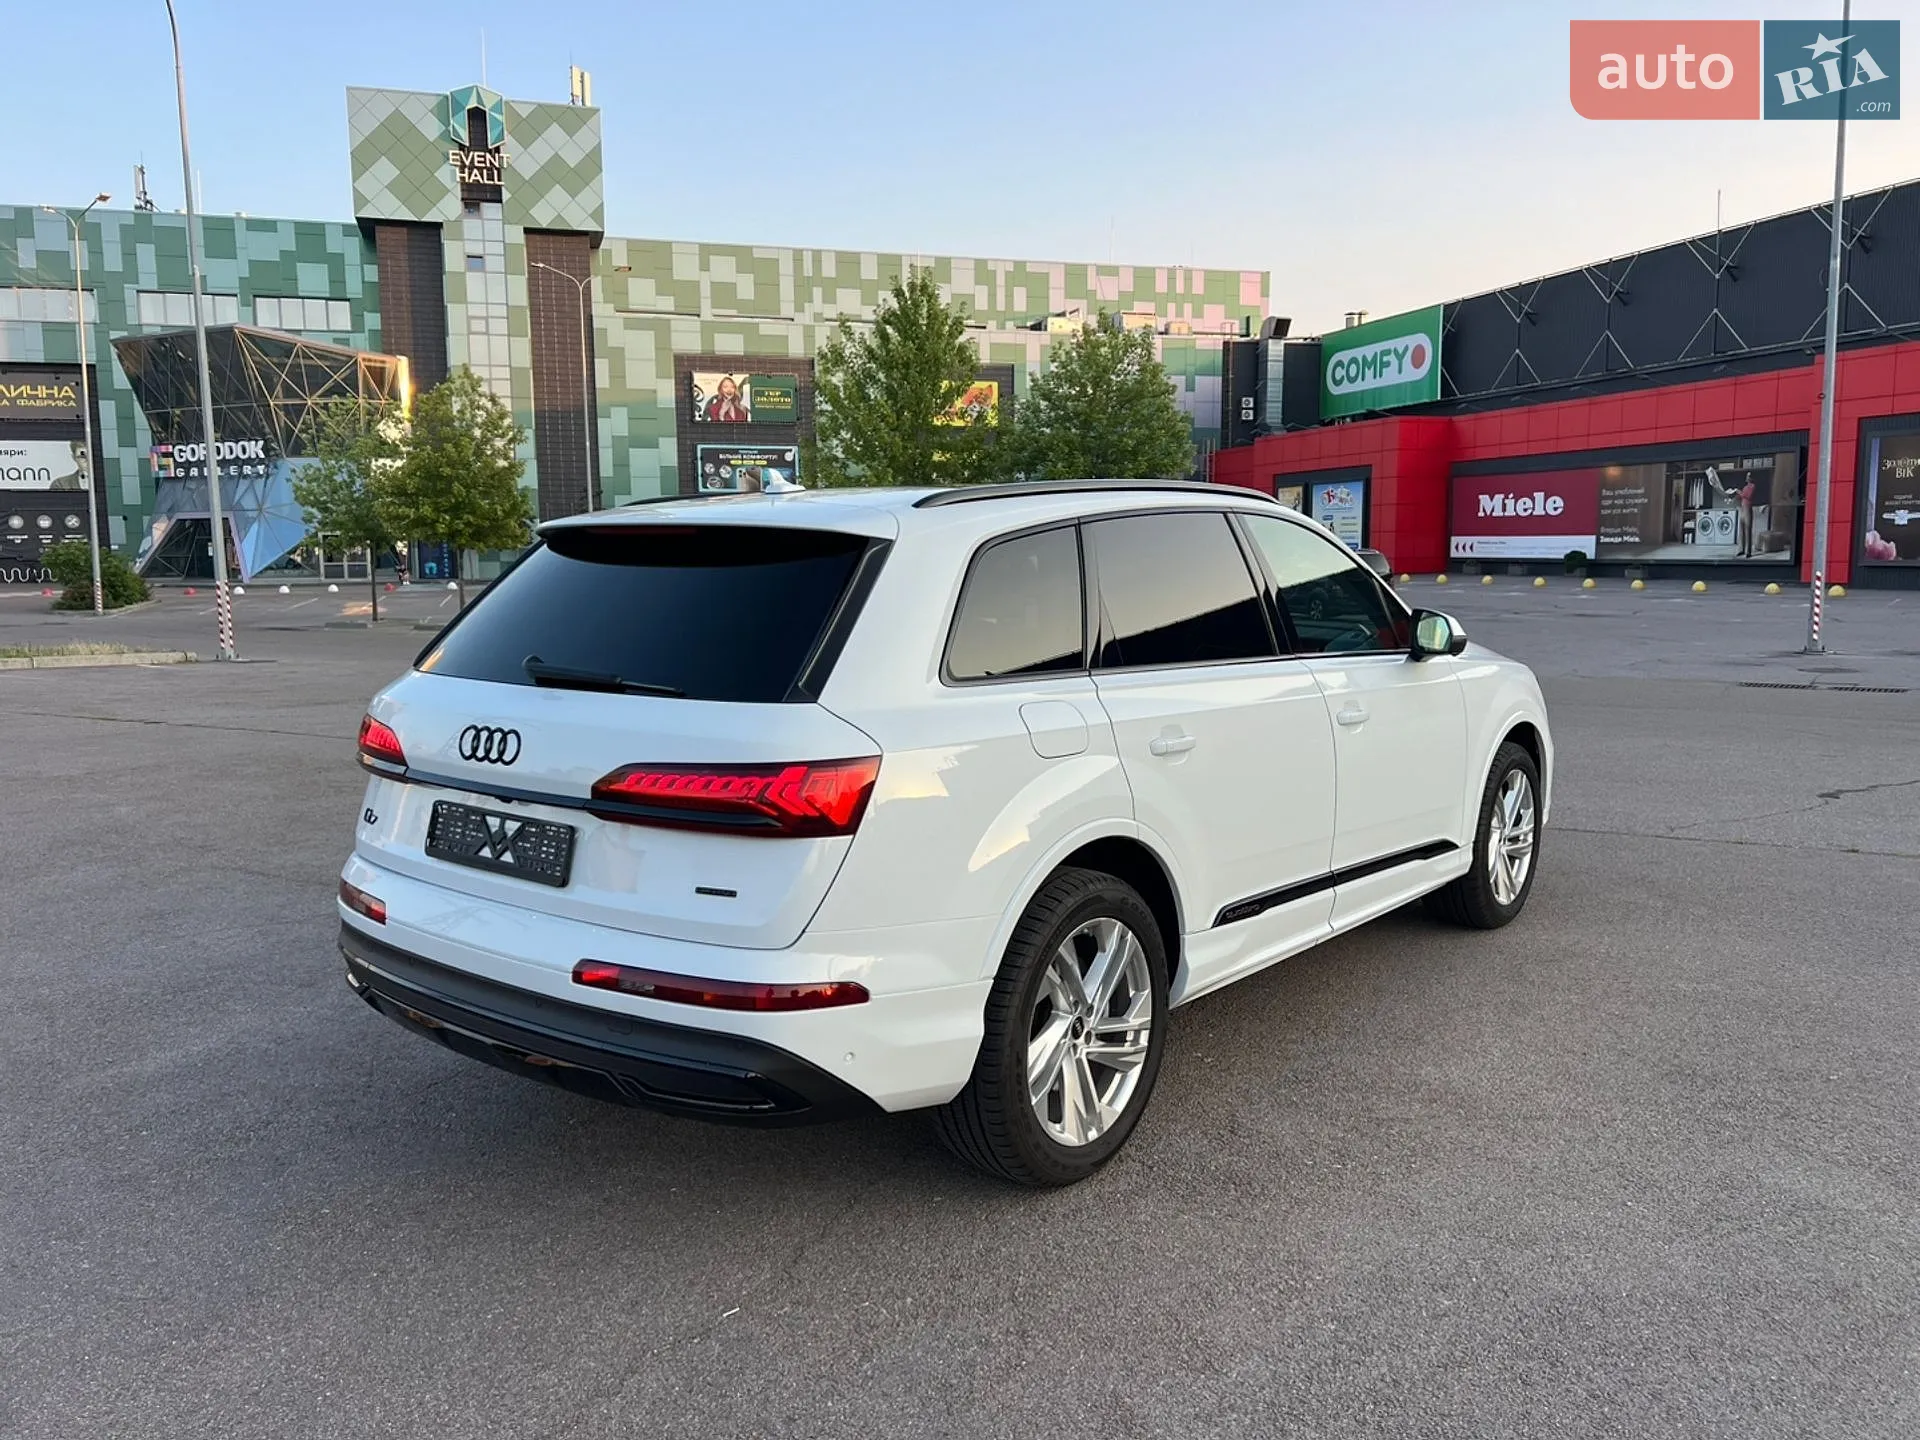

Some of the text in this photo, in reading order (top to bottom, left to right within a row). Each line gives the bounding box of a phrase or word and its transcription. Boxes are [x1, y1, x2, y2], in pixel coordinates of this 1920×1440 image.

[449, 150, 511, 168] EVENT
[456, 168, 505, 185] HALL
[1330, 343, 1409, 388] COMFY
[16, 399, 77, 407] ФАБРИКА
[0, 449, 28, 458] яри:
[173, 440, 265, 463] GORODOK
[0, 467, 50, 481] ann
[1478, 492, 1564, 517] Miele
